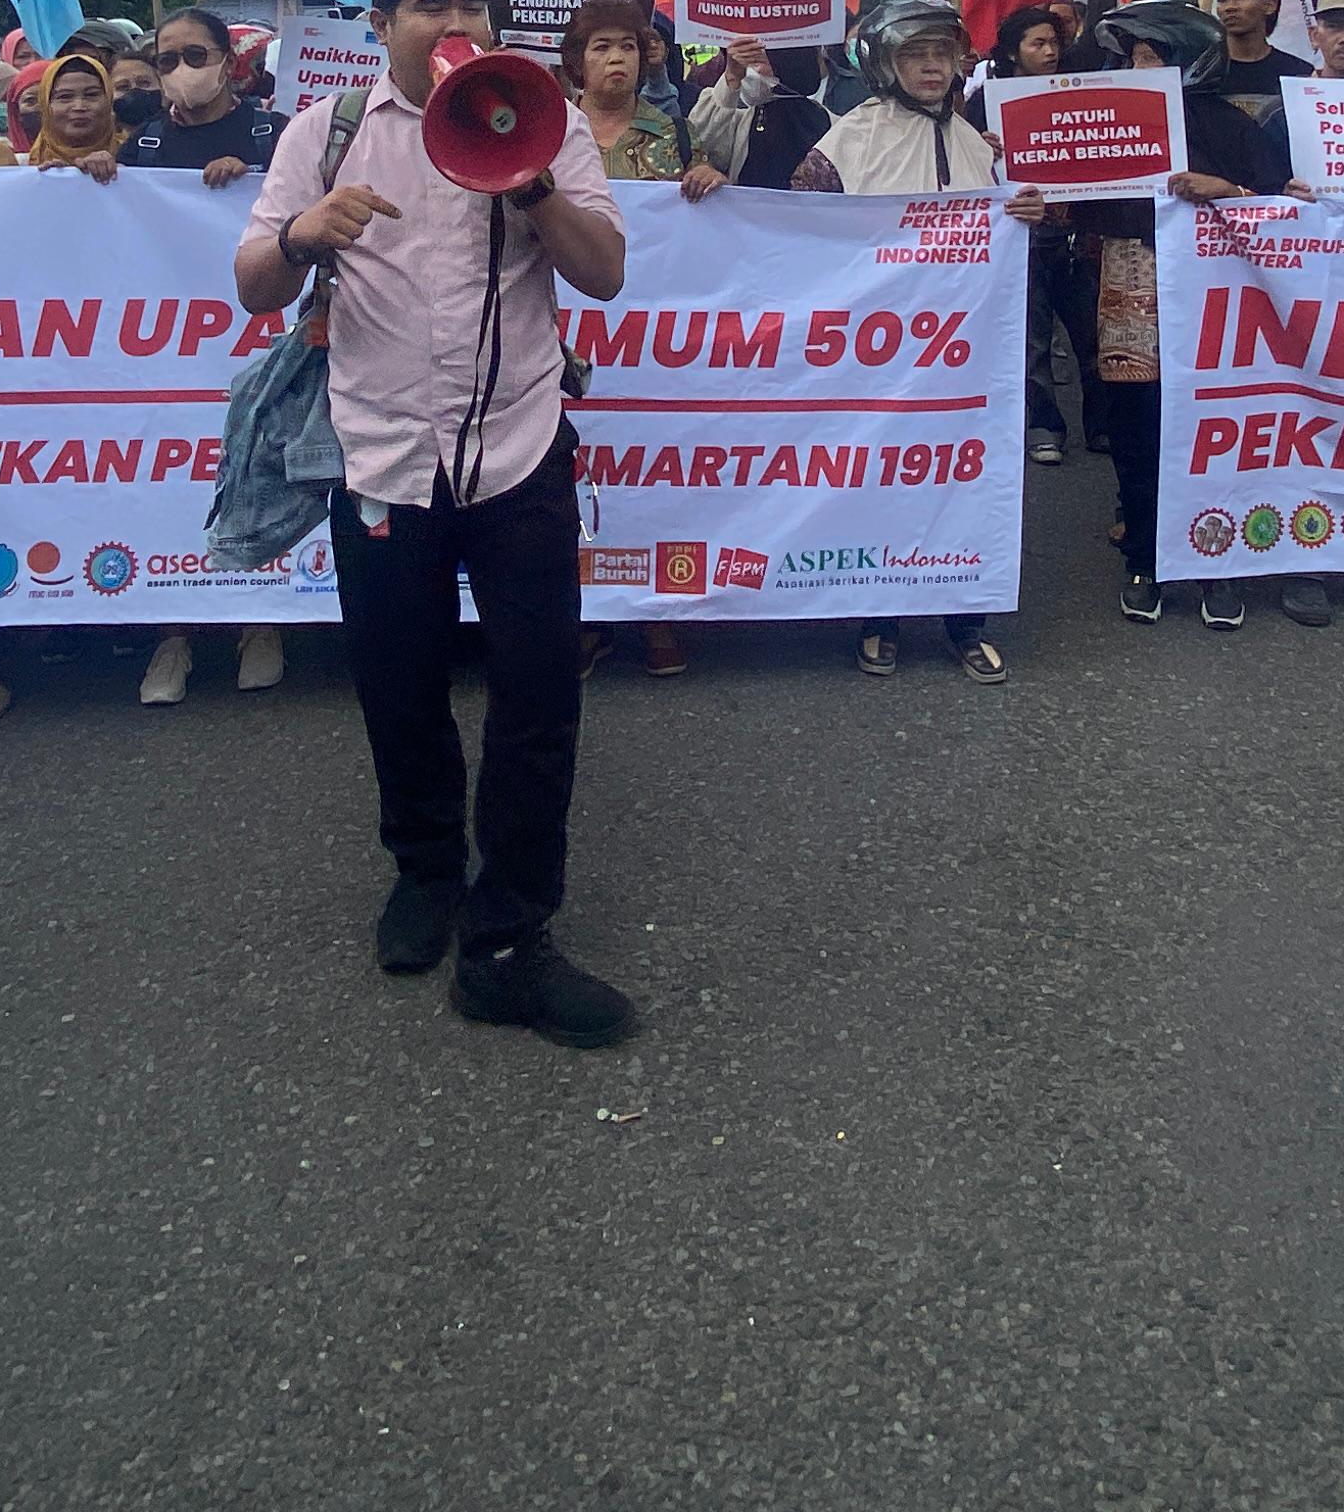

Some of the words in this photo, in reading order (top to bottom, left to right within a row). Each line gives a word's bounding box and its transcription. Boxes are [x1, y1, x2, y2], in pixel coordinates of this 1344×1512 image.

[512, 9, 572, 25] PEKERJA
[698, 2, 745, 18] /UNION
[749, 3, 821, 19] BUSTING
[299, 46, 381, 66] Naikkan
[297, 70, 347, 88] Upah
[1051, 108, 1116, 126] PATUHI
[1029, 125, 1141, 145] PERJANJIAN
[1012, 148, 1071, 165] KERJA
[1074, 142, 1163, 161] BERSAMA
[906, 197, 993, 214] MAJELIS
[899, 213, 991, 229] PEKERJA
[919, 230, 992, 246] BURUH
[875, 247, 991, 264] INDONESIA
[804, 310, 972, 368] 50%
[878, 438, 986, 487] 1918
[594, 552, 649, 568] Partai
[777, 546, 877, 575] ASPEK
[882, 544, 982, 568] Indonesia
[183, 577, 212, 587] trade
[215, 576, 247, 586] union
[250, 575, 290, 586] council
[594, 568, 648, 581] Buruh
[874, 574, 919, 585] Pekerja
[922, 573, 980, 584] Indonesia
